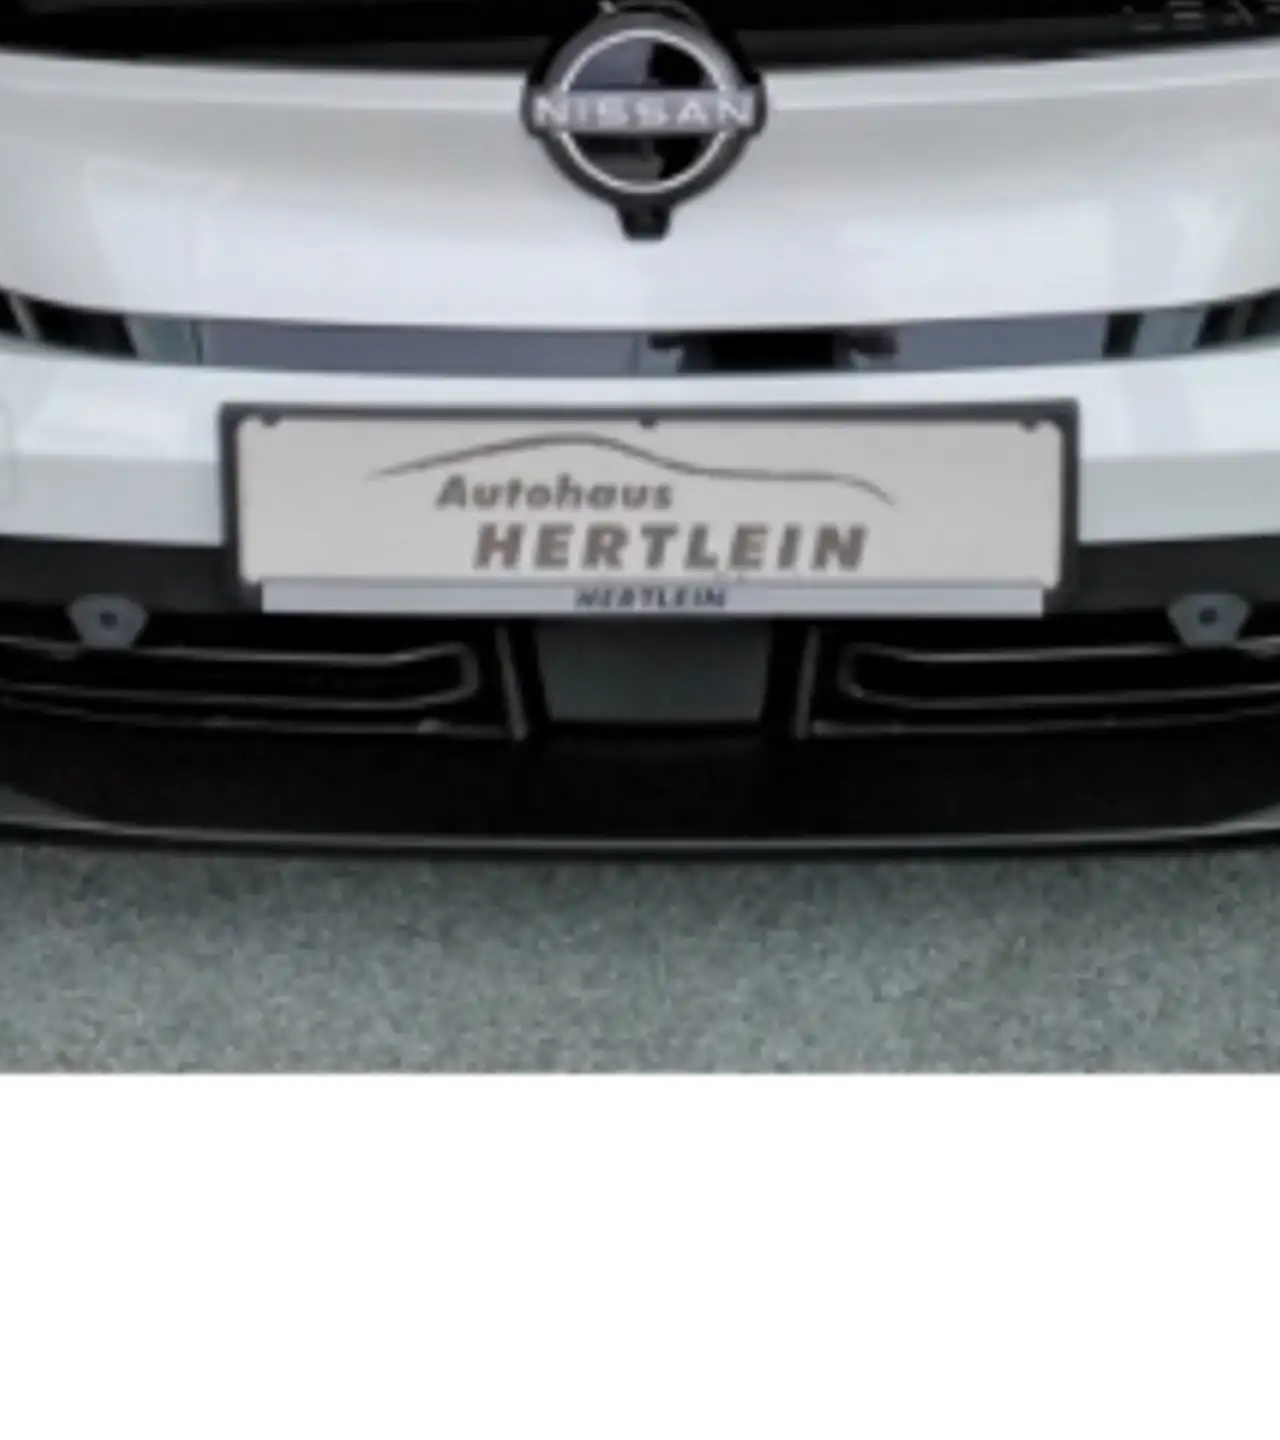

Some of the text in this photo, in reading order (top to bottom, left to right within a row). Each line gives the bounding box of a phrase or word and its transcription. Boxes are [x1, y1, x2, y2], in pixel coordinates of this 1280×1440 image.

[532, 94, 755, 130] NISSAN
[435, 474, 673, 511] Autohaus
[472, 522, 868, 571] HERTLEIN
[575, 586, 726, 608] HERTLEIN
